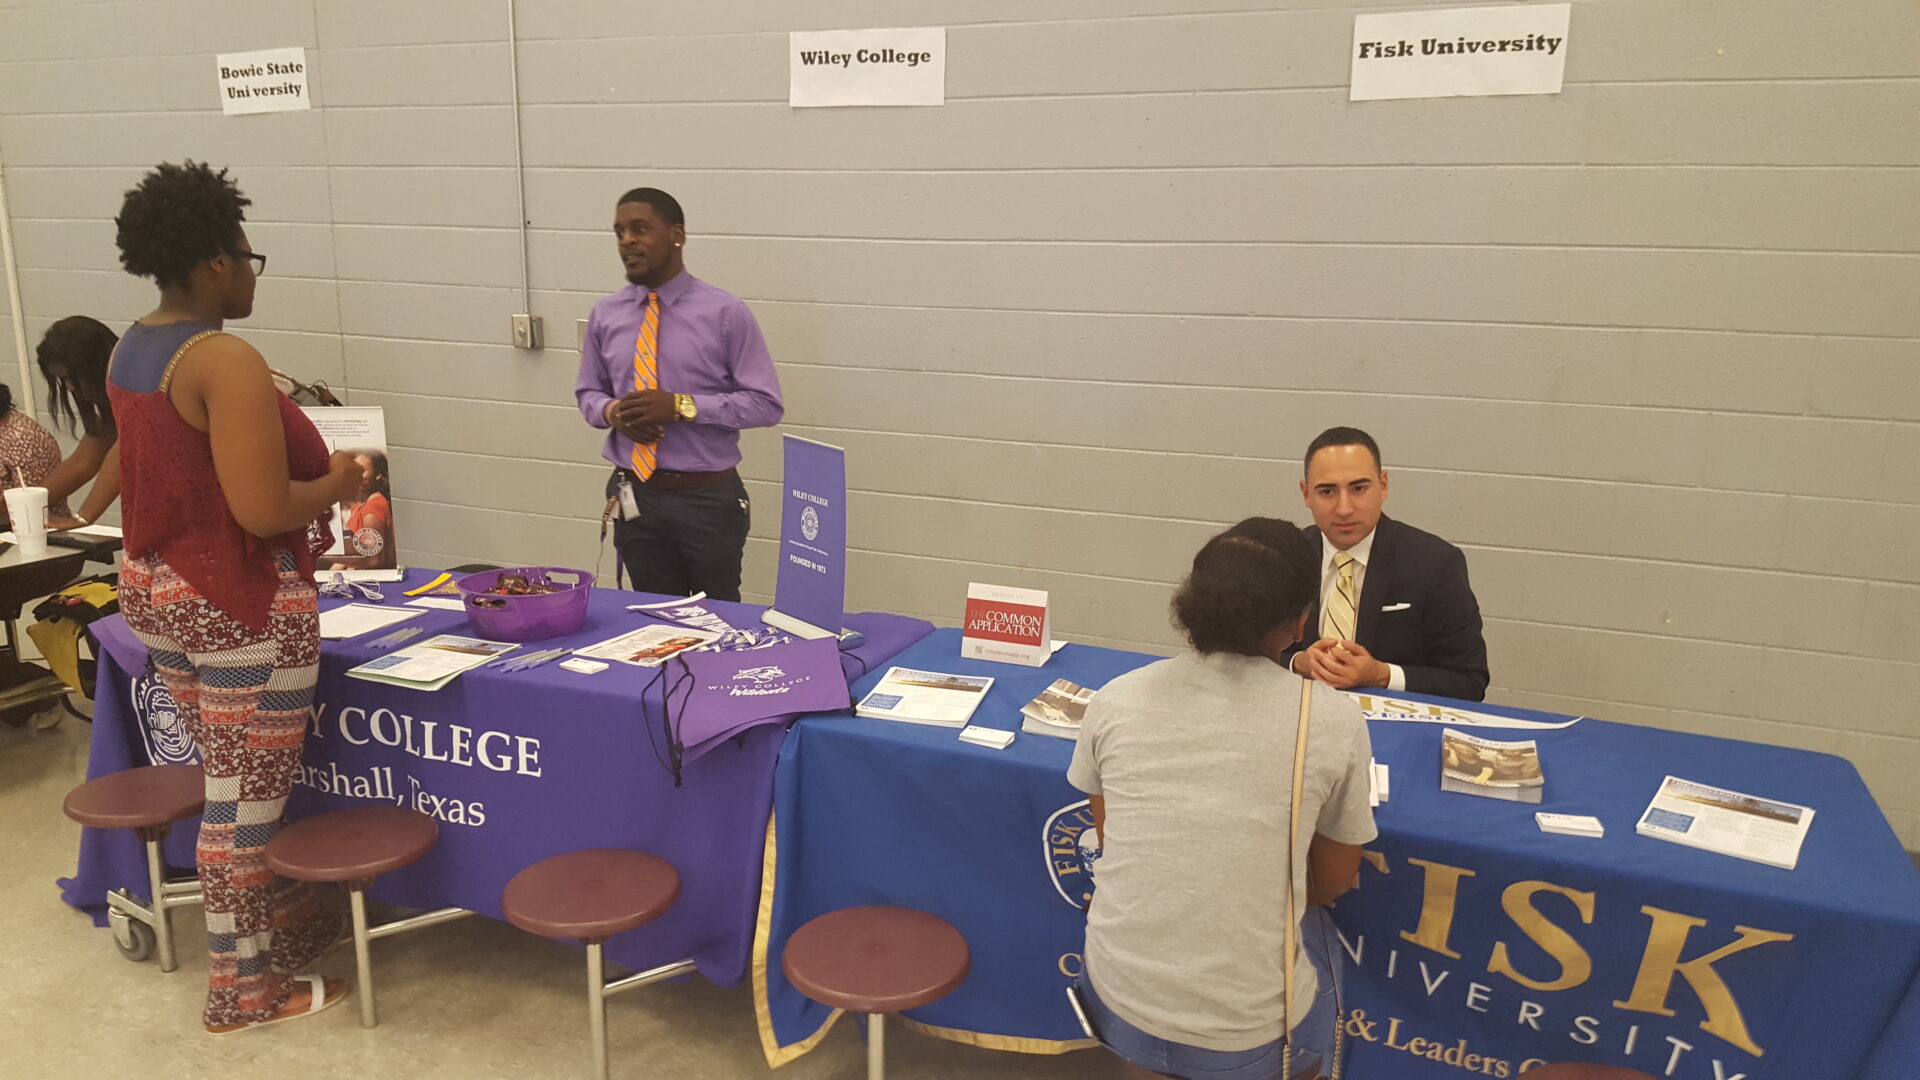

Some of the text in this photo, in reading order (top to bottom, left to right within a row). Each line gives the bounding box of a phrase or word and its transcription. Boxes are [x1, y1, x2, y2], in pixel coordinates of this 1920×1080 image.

[1358, 34, 1563, 59] Fisk University
[800, 48, 931, 69] Wiley College
[221, 61, 304, 80] Bowie State
[792, 489, 829, 507] WILEY COLLEGE
[789, 553, 812, 568] FOUNDED
[968, 619, 1041, 638] APPLICATION
[985, 610, 1042, 627] COMMON
[754, 675, 811, 689] COLLEGE
[338, 706, 542, 777] COLLEGE
[291, 761, 486, 827] arshall, Texas
[1051, 819, 1082, 878] FISK
[1360, 849, 1795, 1057] ISK
[1336, 928, 1746, 1080] NIVERSIT
[1344, 1007, 1379, 1042] &
[1383, 1016, 1511, 1078] Leaders
